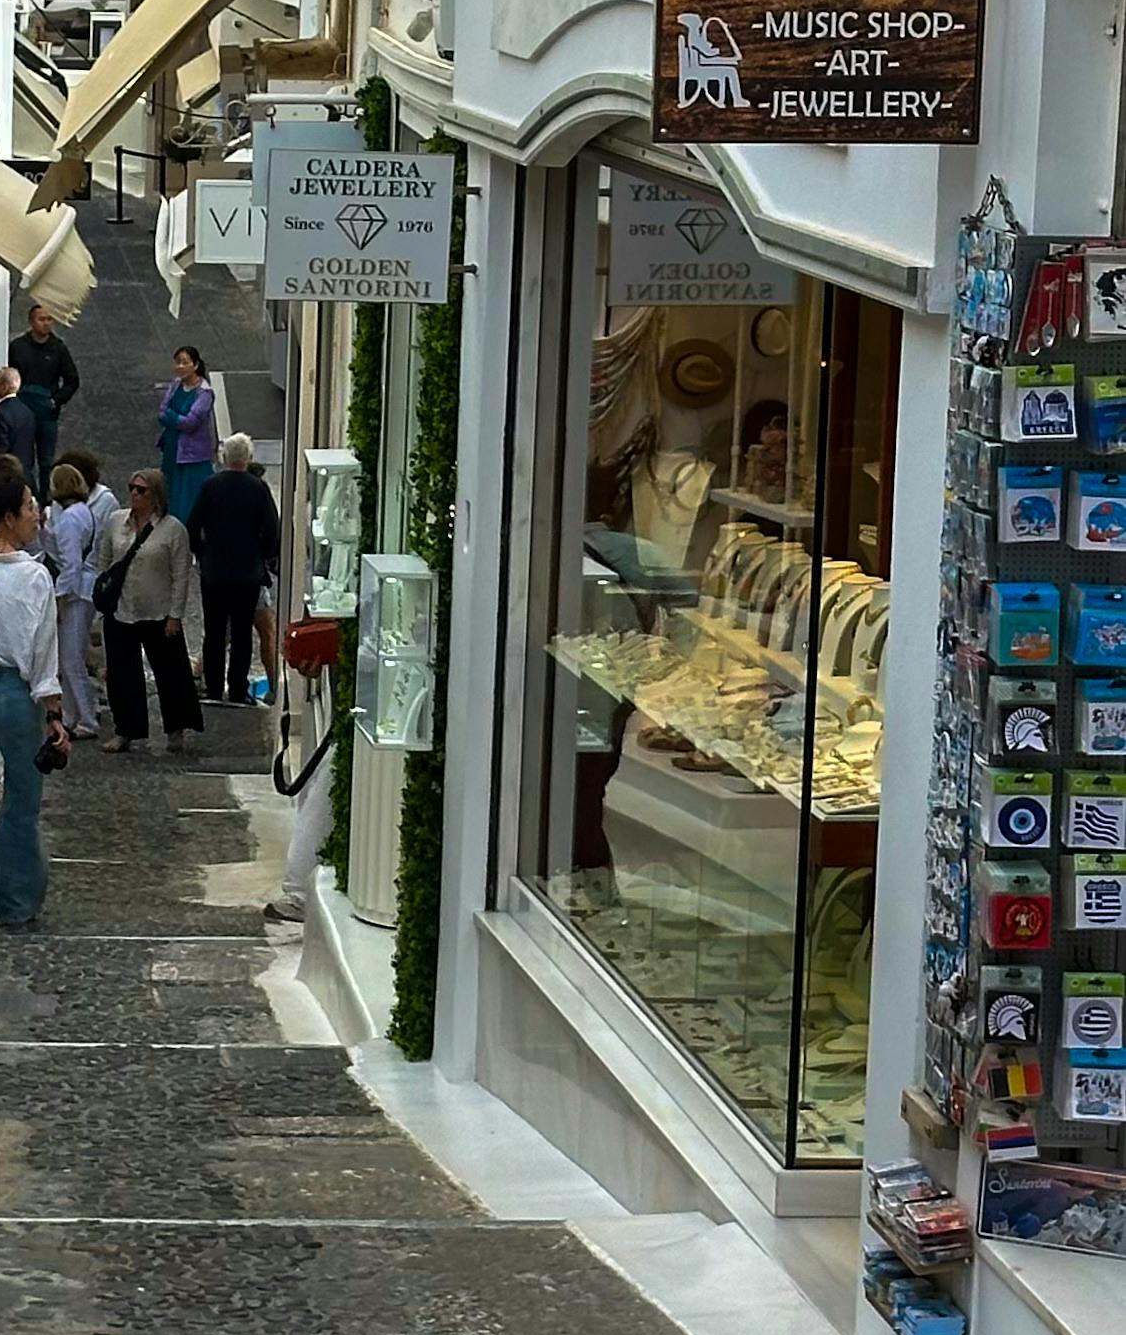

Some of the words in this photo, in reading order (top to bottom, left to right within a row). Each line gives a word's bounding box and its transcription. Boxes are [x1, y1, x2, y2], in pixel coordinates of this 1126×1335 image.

[306, 158, 422, 179] CALDERA
[289, 177, 436, 199] JEWELLERY
[284, 216, 324, 231] Since
[397, 220, 433, 233] 1976
[308, 257, 411, 277] GOLDEN
[284, 276, 432, 299] SANTORINI
